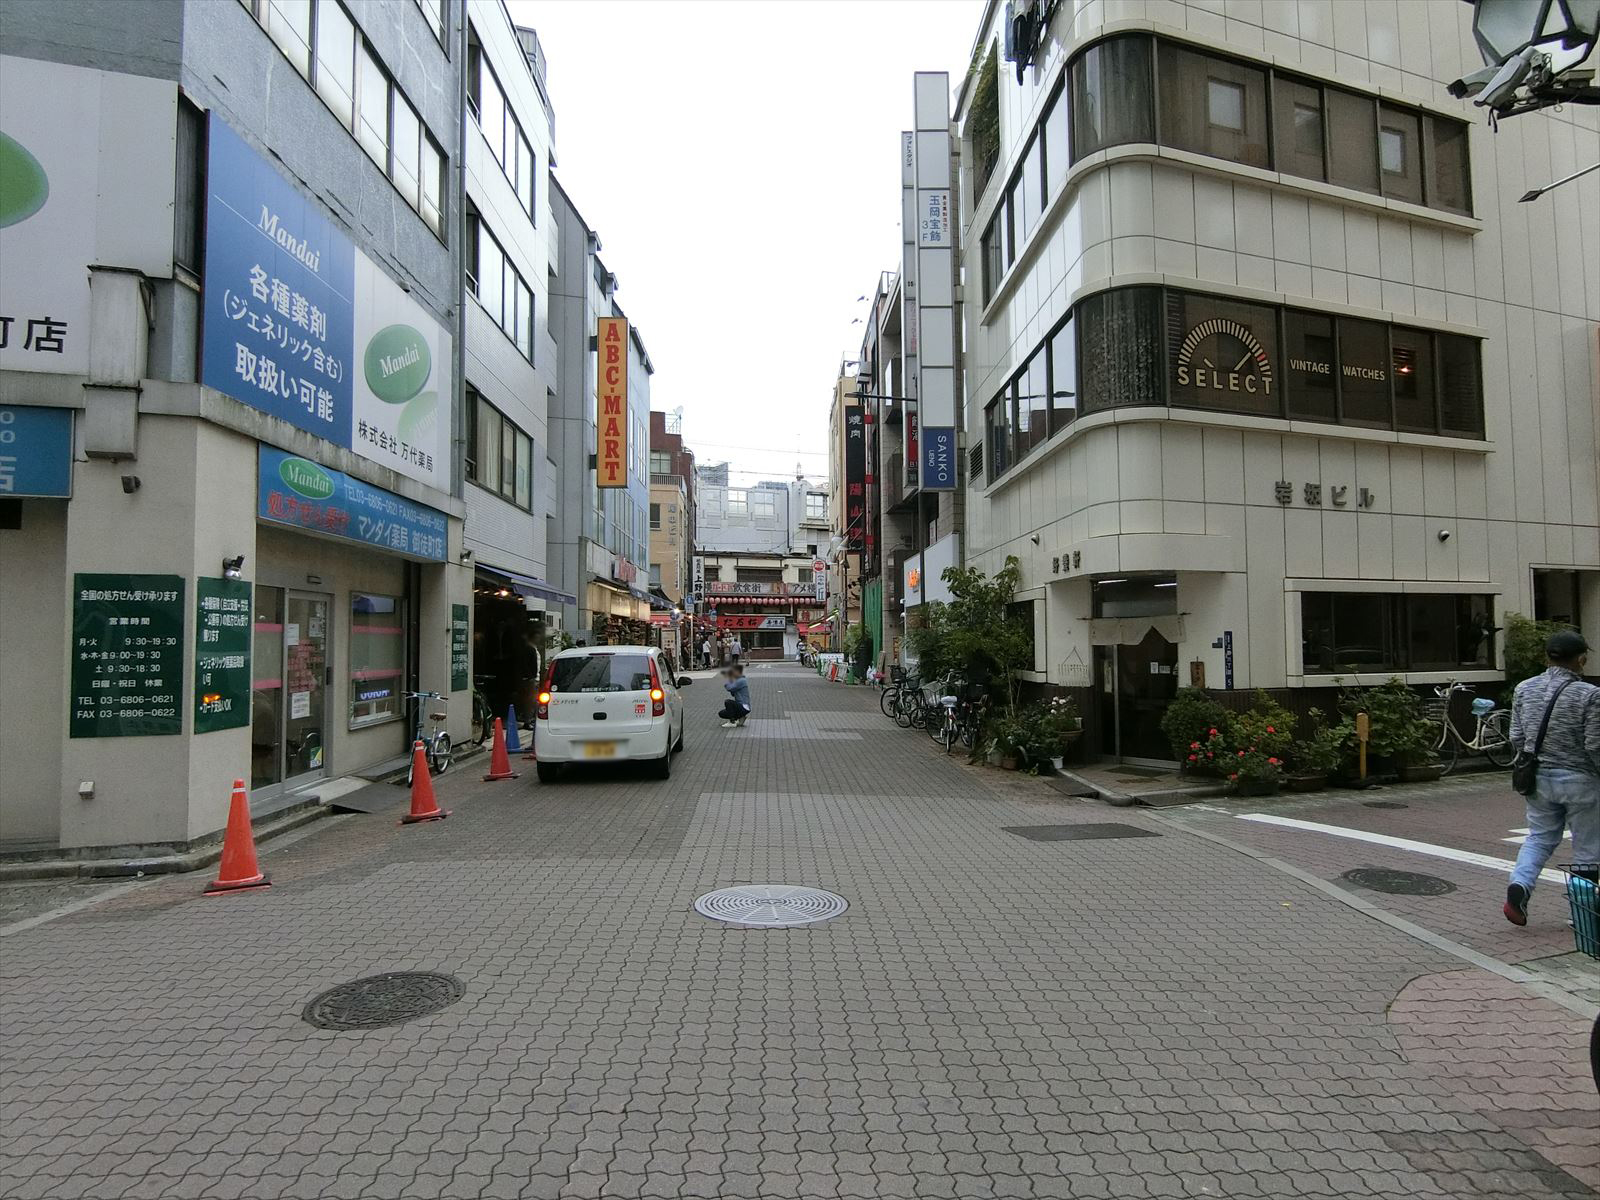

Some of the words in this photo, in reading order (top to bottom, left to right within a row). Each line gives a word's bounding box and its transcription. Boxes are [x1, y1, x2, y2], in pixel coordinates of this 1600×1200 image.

[929, 195, 941, 242] 玉岡宝飾
[257, 205, 321, 273] Mandai
[249, 264, 327, 342] 各種薬剤
[379, 343, 420, 378] Mandai
[1290, 359, 1330, 374] VINTAGE
[1342, 365, 1385, 381] WATCHES
[235, 342, 334, 423] 取扱い可能
[1177, 366, 1273, 395] SELECT
[358, 418, 398, 456] 株式会社
[401, 441, 433, 473] 万代薬局
[937, 435, 948, 482] SANKO
[287, 464, 330, 493] Mandai
[358, 515, 408, 551] マンダイ薬局
[412, 529, 442, 559] 御徒町店
[80, 590, 178, 602] 全国の処方せん受け承ります
[108, 617, 150, 626] 営業時間
[95, 665, 103, 673] 土
[144, 679, 163, 688] 休業
[77, 710, 95, 719] FAX
[99, 708, 176, 718] 03-6806-0622
[78, 696, 95, 705] TEL
[100, 695, 174, 705] 03-6806-0621
